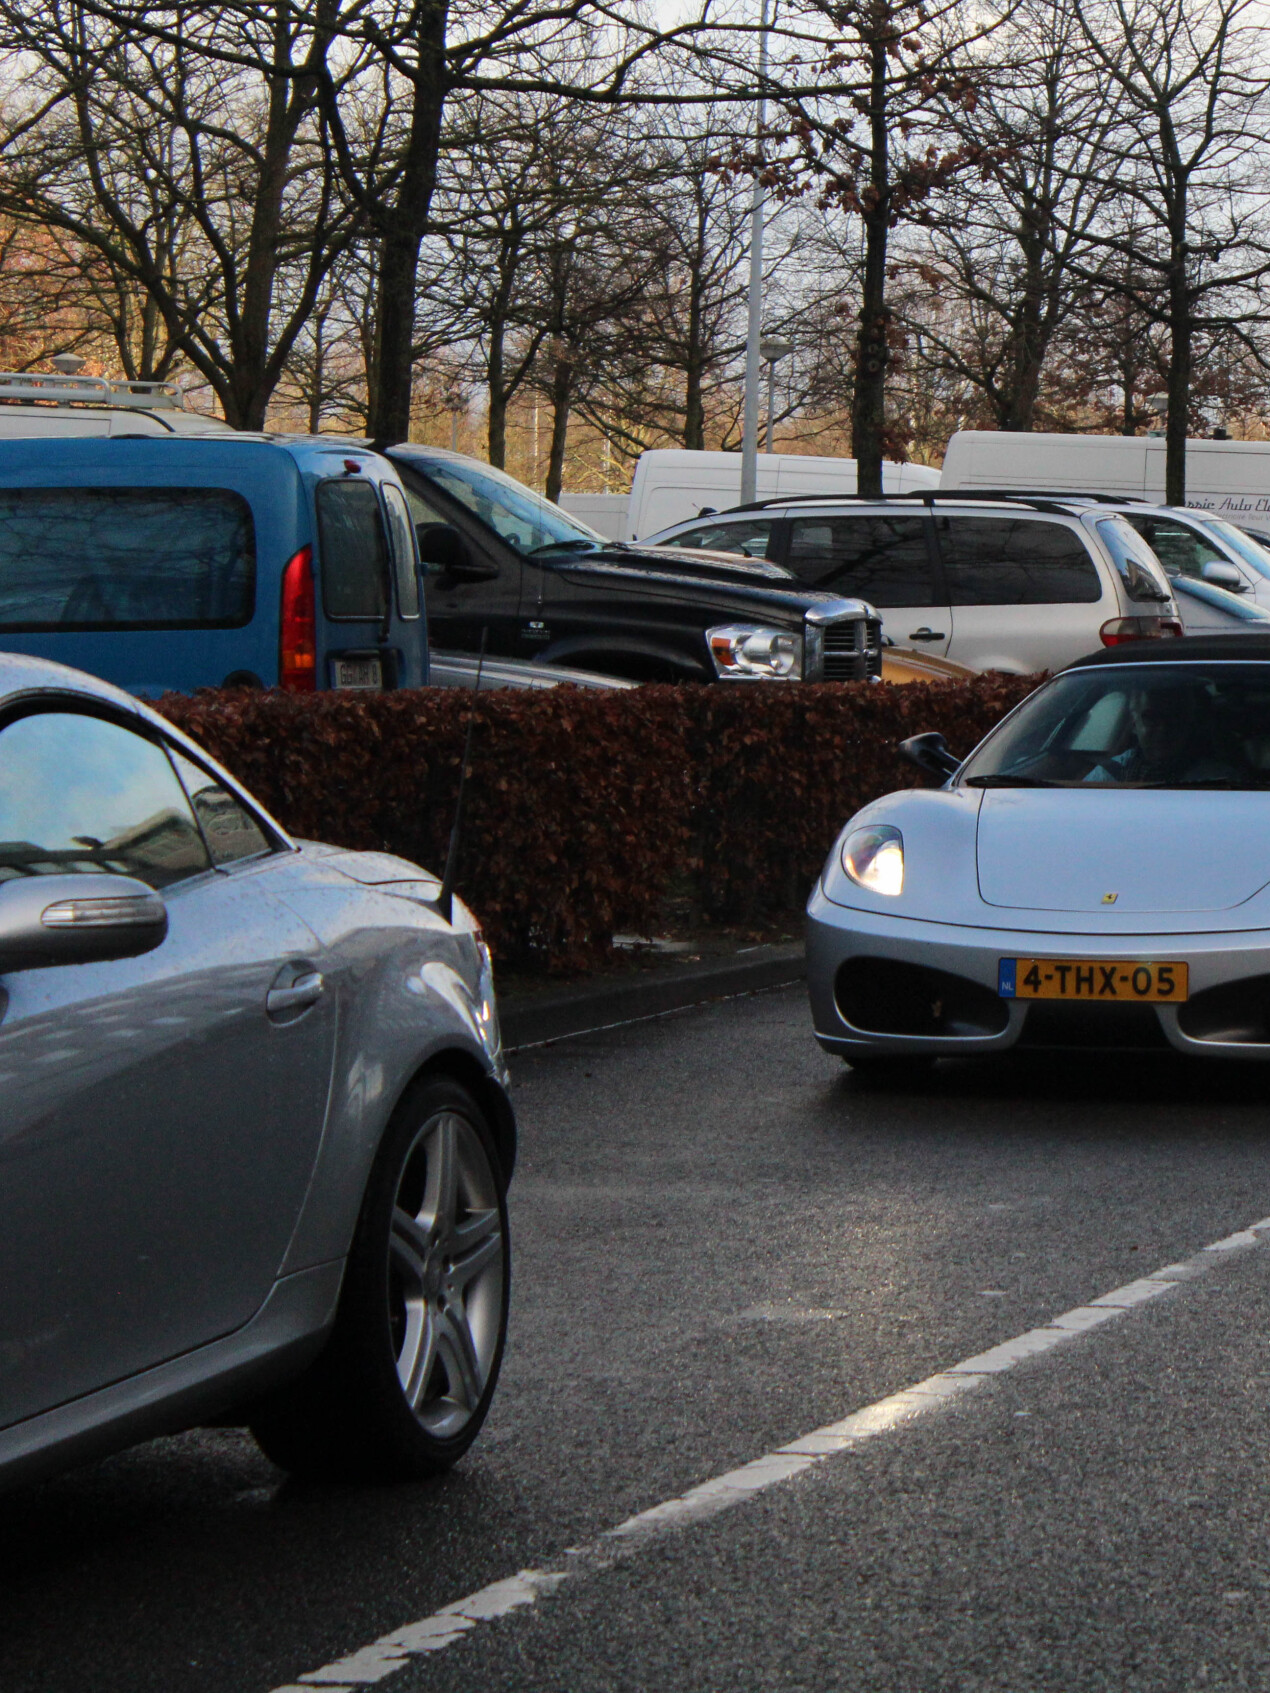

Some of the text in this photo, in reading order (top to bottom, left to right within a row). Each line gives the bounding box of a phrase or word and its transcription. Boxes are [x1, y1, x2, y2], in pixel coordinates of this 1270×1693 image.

[1186, 498, 1215, 510] ssic
[1219, 497, 1252, 511] Auto
[1002, 964, 1175, 996] NL 4-THX-05
